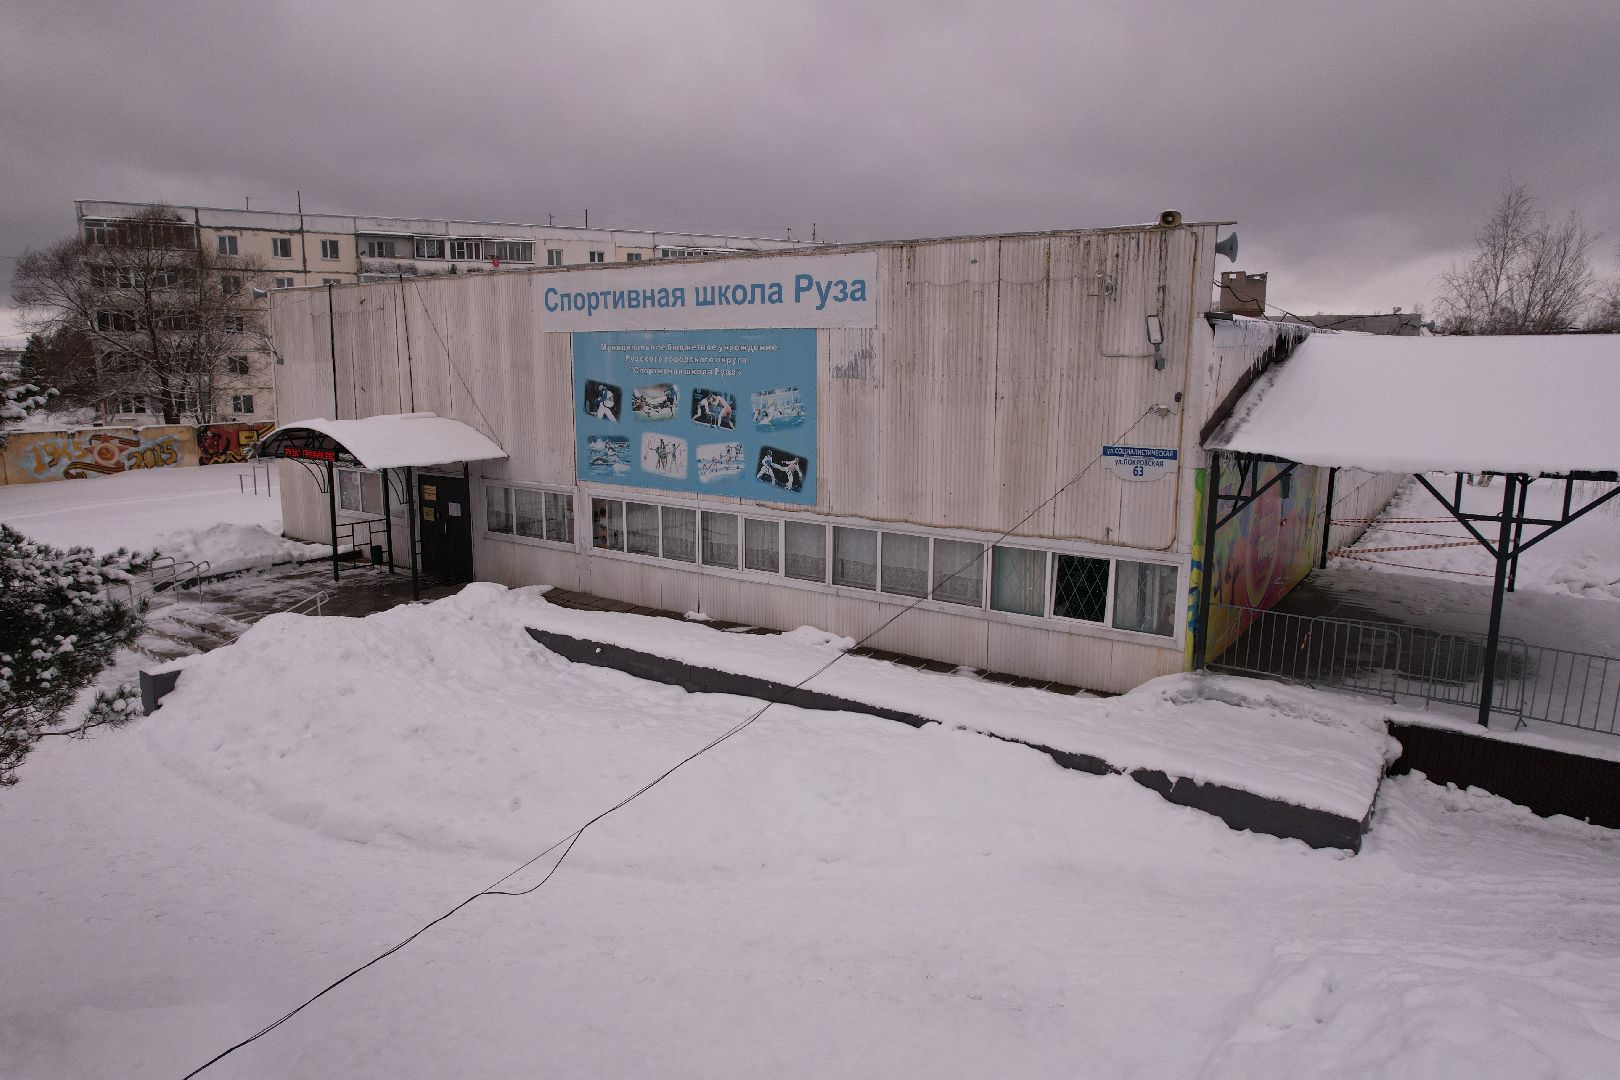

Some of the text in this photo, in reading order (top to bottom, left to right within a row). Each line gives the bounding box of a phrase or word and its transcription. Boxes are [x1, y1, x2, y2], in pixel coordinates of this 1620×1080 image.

[544, 273, 867, 316] Спортивная школа Руза
[601, 343, 778, 353] Муниципальное бюджетное учреждение
[625, 354, 747, 365] Рузского городского округа
[684, 367, 713, 376] школа
[32, 438, 178, 473] 1945 2015
[1133, 466, 1144, 477] 63
